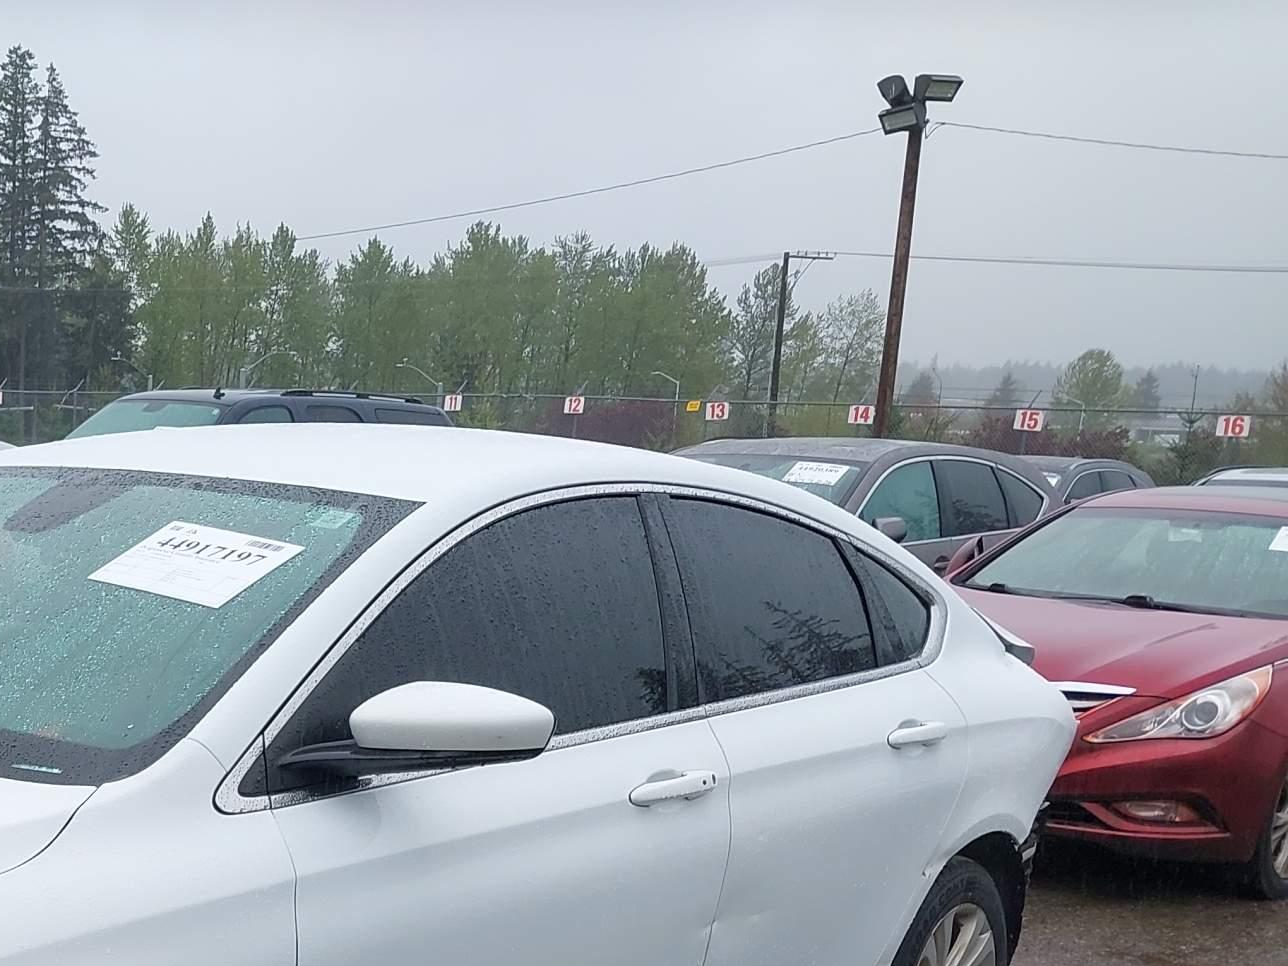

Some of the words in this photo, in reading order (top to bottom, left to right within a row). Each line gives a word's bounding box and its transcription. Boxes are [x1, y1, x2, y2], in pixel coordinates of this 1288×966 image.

[568, 398, 581, 412] 12
[710, 403, 726, 419] 13
[853, 406, 870, 423] 14
[1020, 411, 1040, 429] 15
[1223, 416, 1245, 436] 16
[157, 536, 268, 566] 44917197
